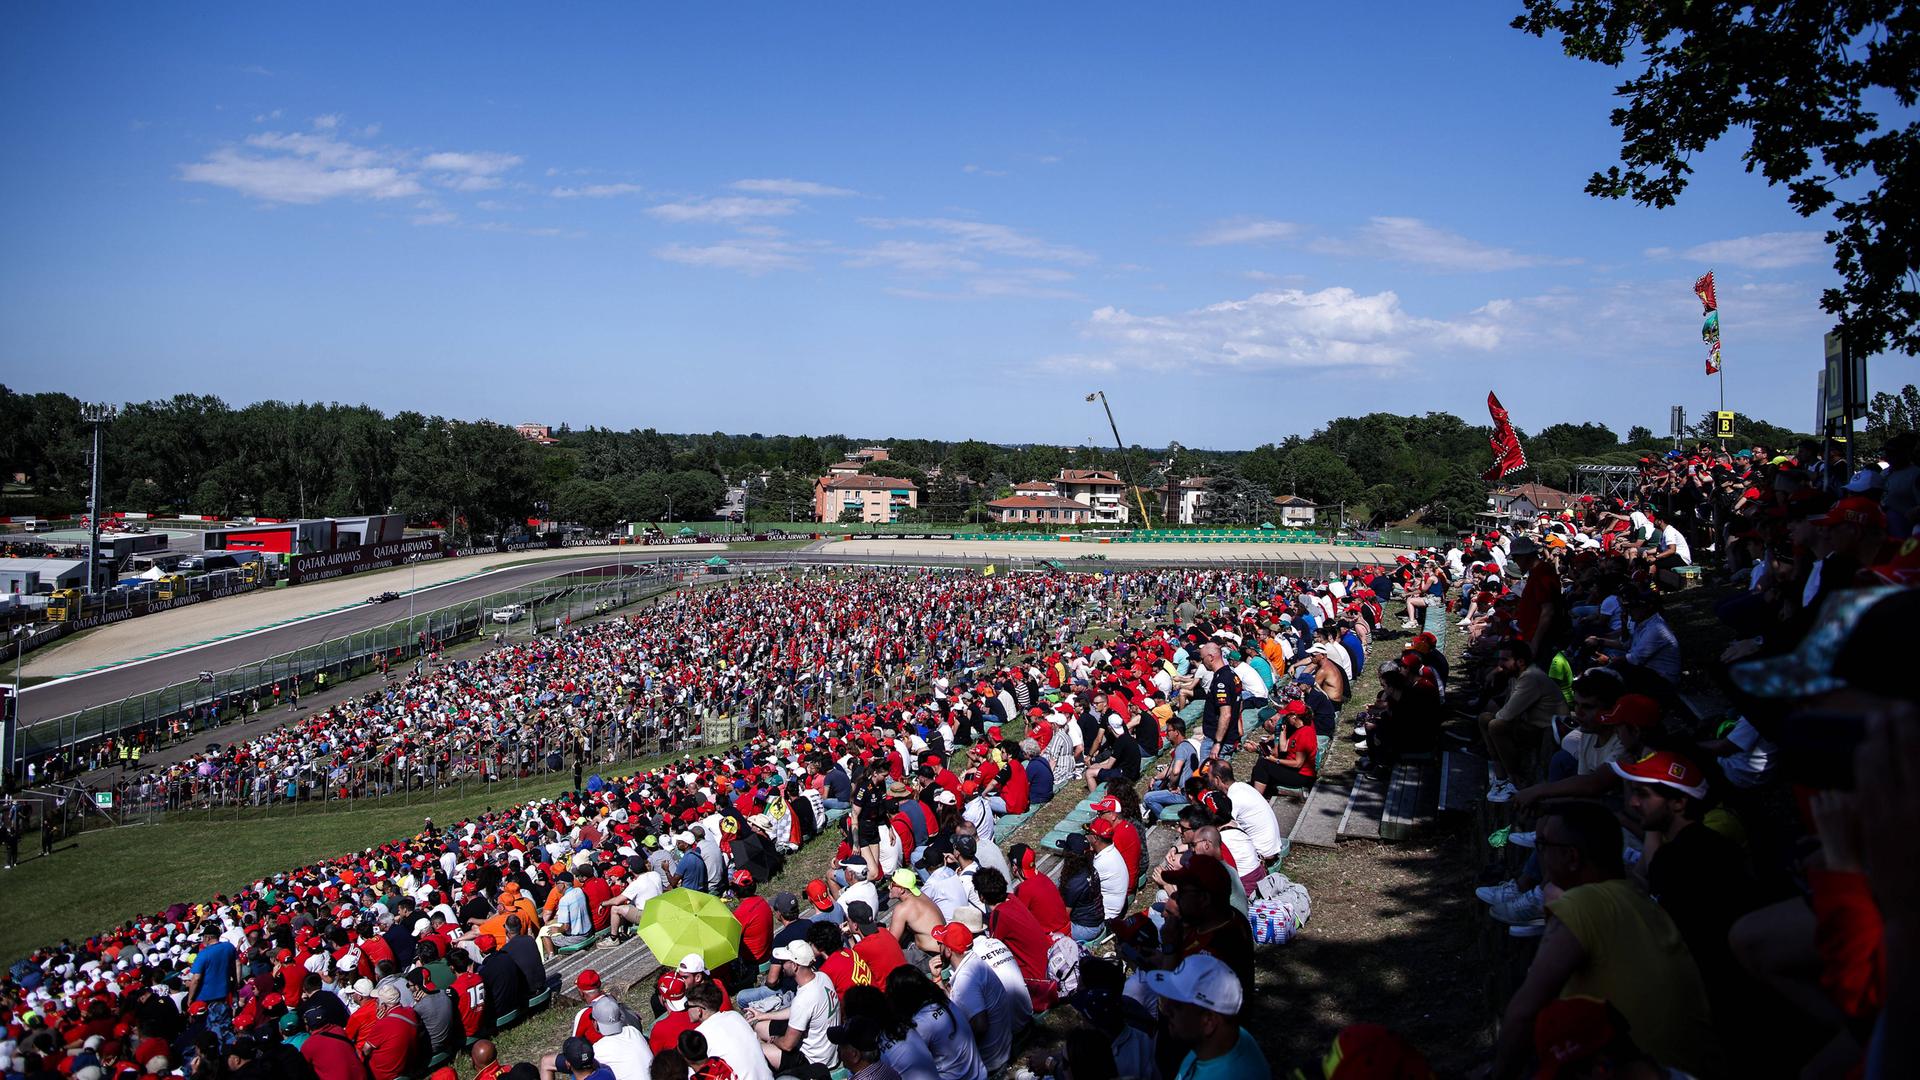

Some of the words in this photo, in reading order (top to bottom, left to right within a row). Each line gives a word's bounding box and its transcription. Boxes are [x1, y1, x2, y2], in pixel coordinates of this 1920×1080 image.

[1722, 420, 1730, 431] B
[374, 544, 398, 558] QATAR
[399, 540, 433, 553] AIRWAYS
[507, 543, 525, 551] QATAR
[526, 541, 548, 549] AIRWAYS
[562, 539, 584, 547] QATAR
[649, 538, 670, 546] QATAR
[421, 551, 443, 561] AIRWAYS
[456, 548, 475, 557] QATAR
[475, 545, 498, 554] AIRWAYS
[298, 556, 325, 572] QATAR
[327, 550, 361, 566] AIRWAYS
[353, 563, 371, 573] QATAR
[371, 560, 393, 570] AIRWAYS
[300, 573, 319, 583] QATAR
[320, 568, 343, 580] AIRWAYS
[212, 588, 232, 599] QATAR
[233, 582, 257, 595] AIRWAYS
[148, 599, 172, 613] QATAR
[173, 593, 202, 607] AIRWAYS
[73, 615, 98, 630] QATAR
[99, 608, 133, 624] AIRWAYS
[447, 927, 465, 941] 16
[467, 983, 485, 1009] 16
